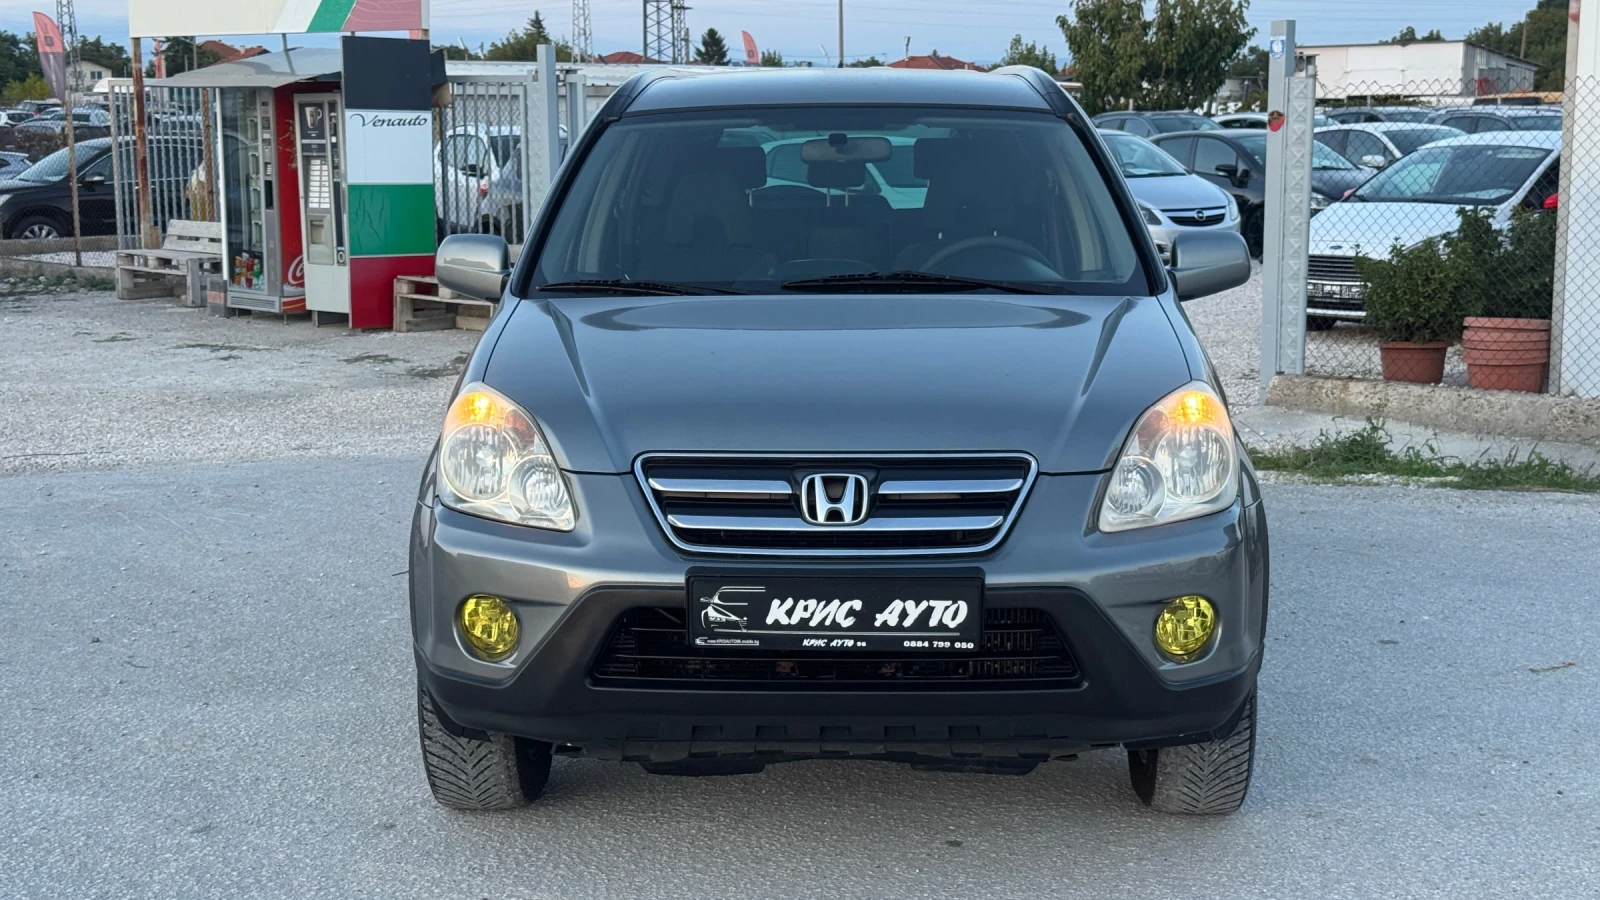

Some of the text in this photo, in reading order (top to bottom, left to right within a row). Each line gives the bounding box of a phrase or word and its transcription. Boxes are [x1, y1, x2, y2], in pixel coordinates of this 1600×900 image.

[349, 113, 428, 128] Venauto
[765, 597, 968, 629] КРИС АУТО
[802, 638, 828, 647] КРИС
[829, 638, 855, 648] АУТО
[903, 640, 974, 649] 0884 799 050
